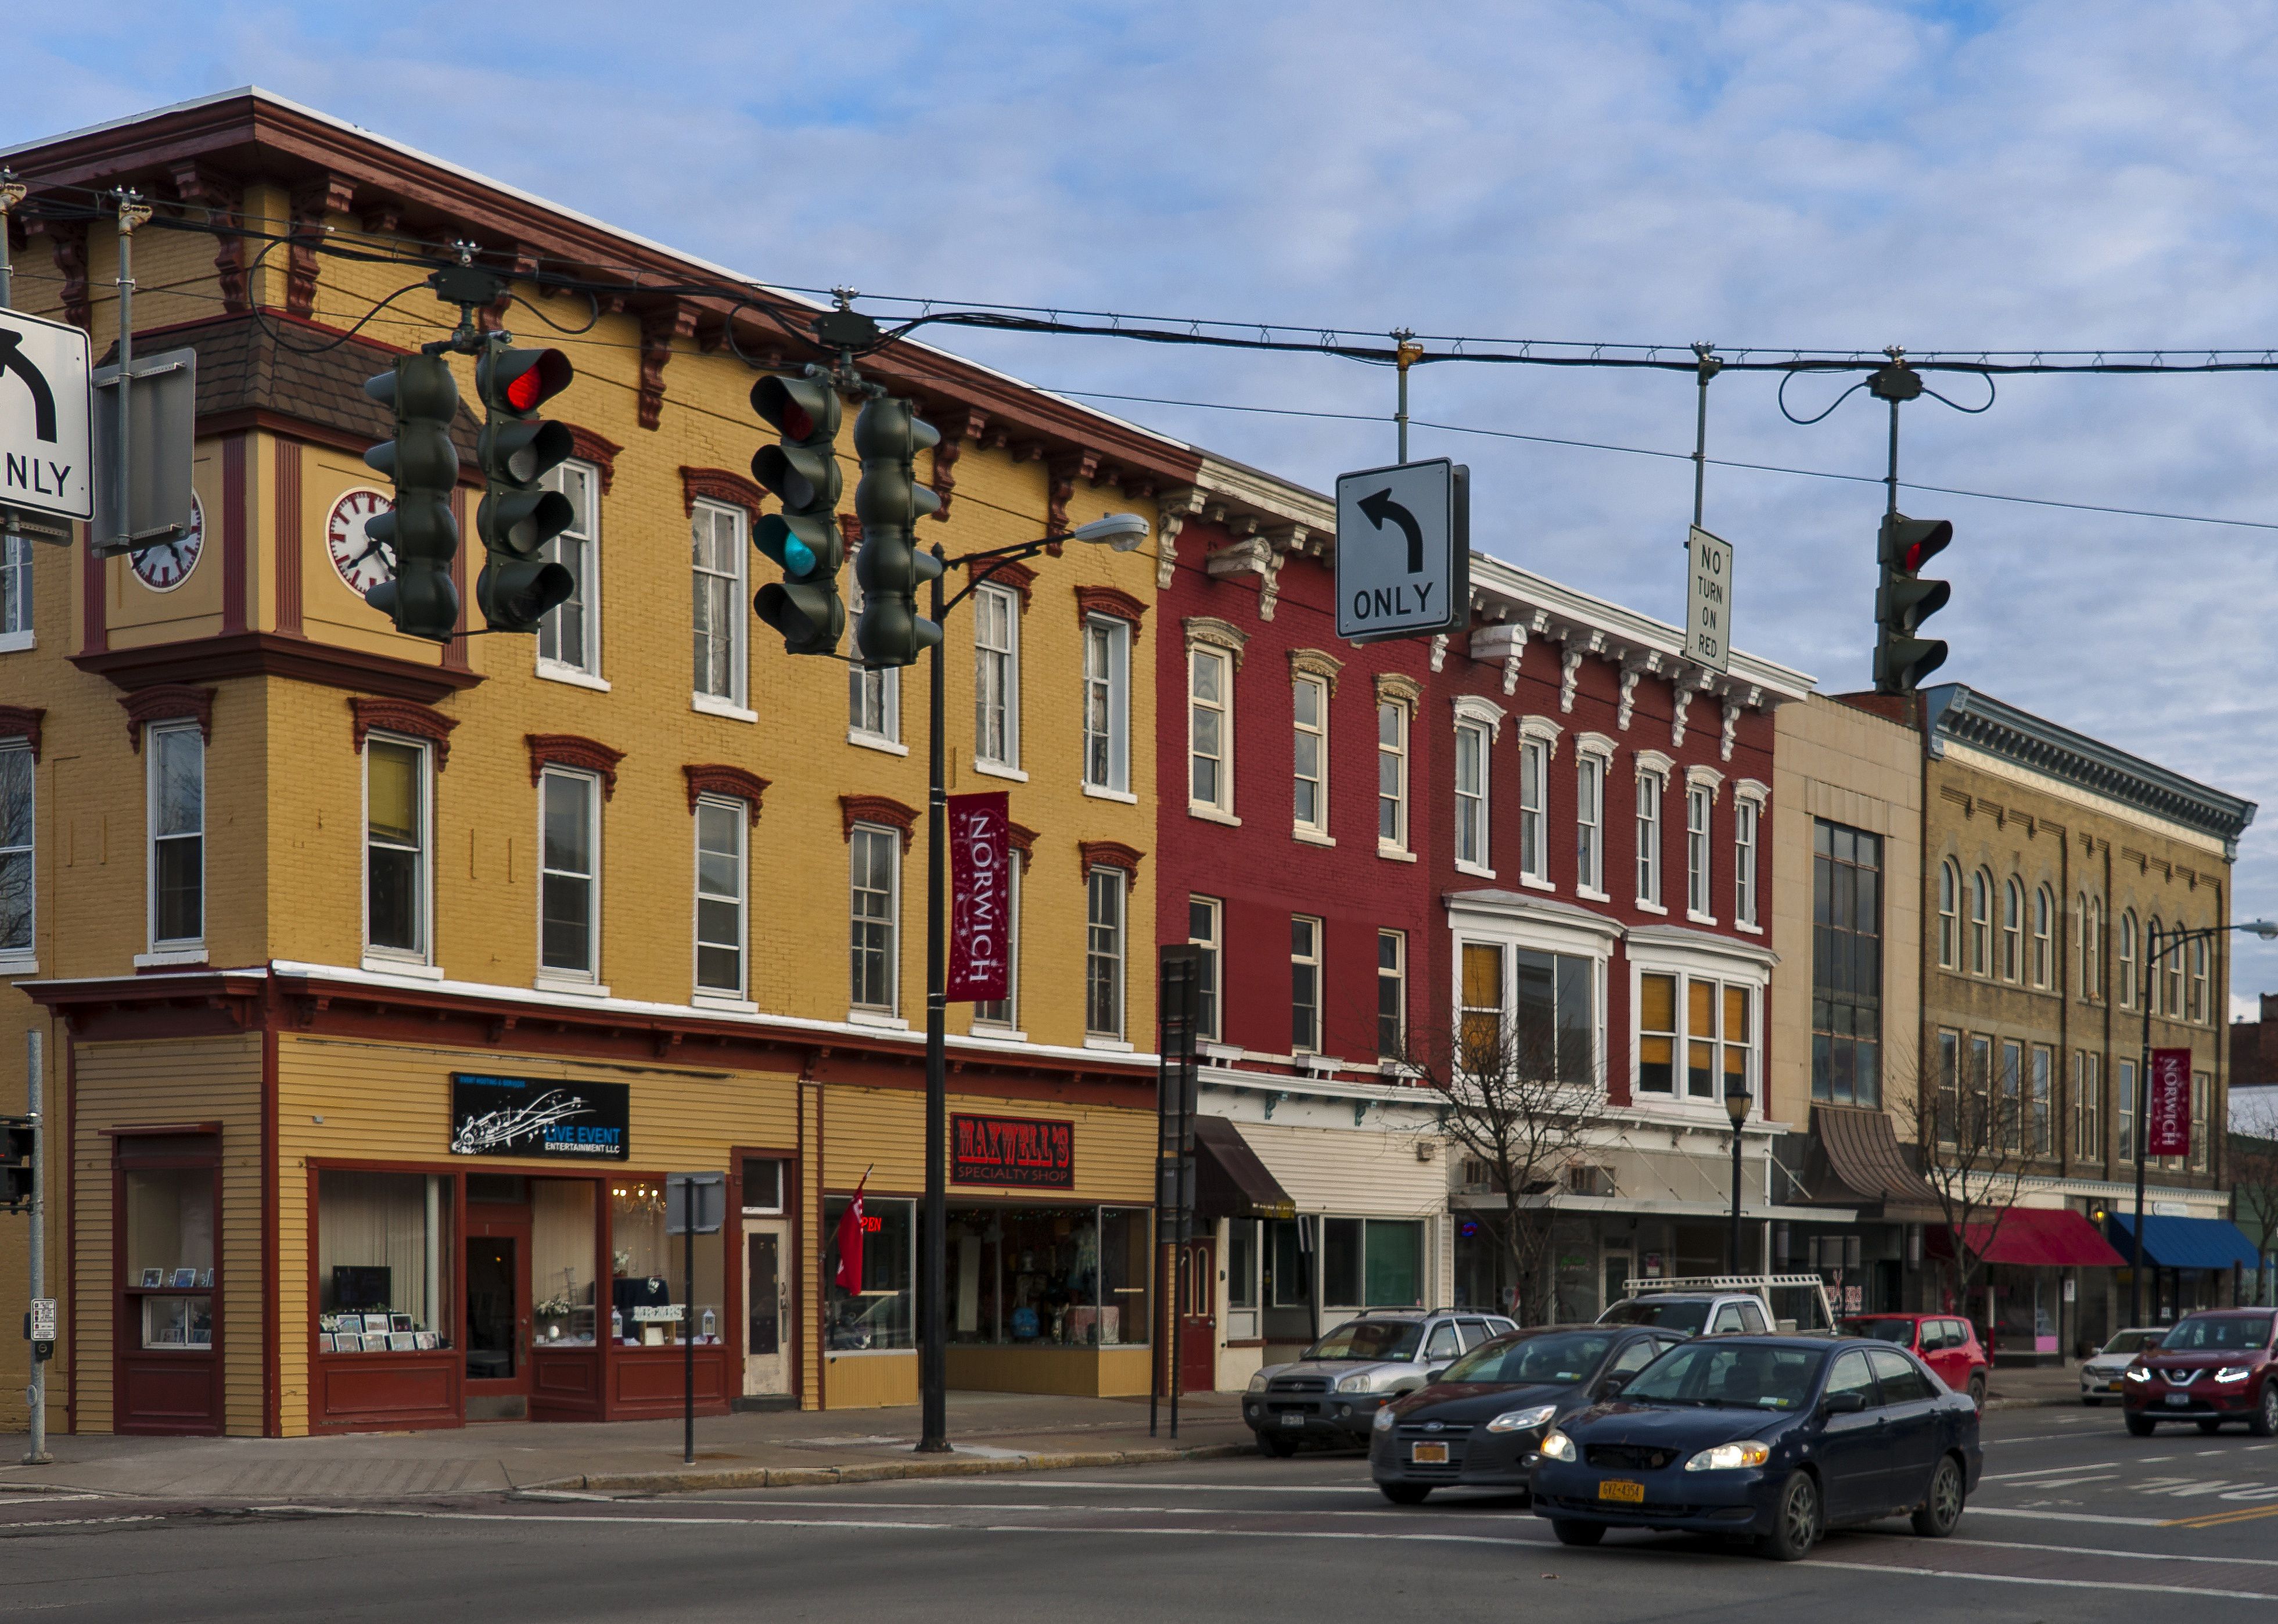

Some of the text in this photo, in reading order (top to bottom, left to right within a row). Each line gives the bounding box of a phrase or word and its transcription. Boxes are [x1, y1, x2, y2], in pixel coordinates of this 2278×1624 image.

[0, 452, 71, 497] NLY
[1701, 544, 1721, 575] NO
[1353, 582, 1434, 620] ONLY
[1698, 576, 1722, 605] TURN
[1702, 606, 1716, 630] ON
[1698, 633, 1717, 658] RED
[969, 816, 993, 982] NORWICH
[2161, 1059, 2178, 1145] NORWICH
[545, 1126, 621, 1144] LIVE EVENT
[545, 1142, 620, 1154] ENTERTAINMENT LLC
[958, 1120, 1069, 1167] MAXWELL'S
[958, 1166, 1068, 1181] SPECIALTY SHOP
[860, 1217, 882, 1232] PEN
